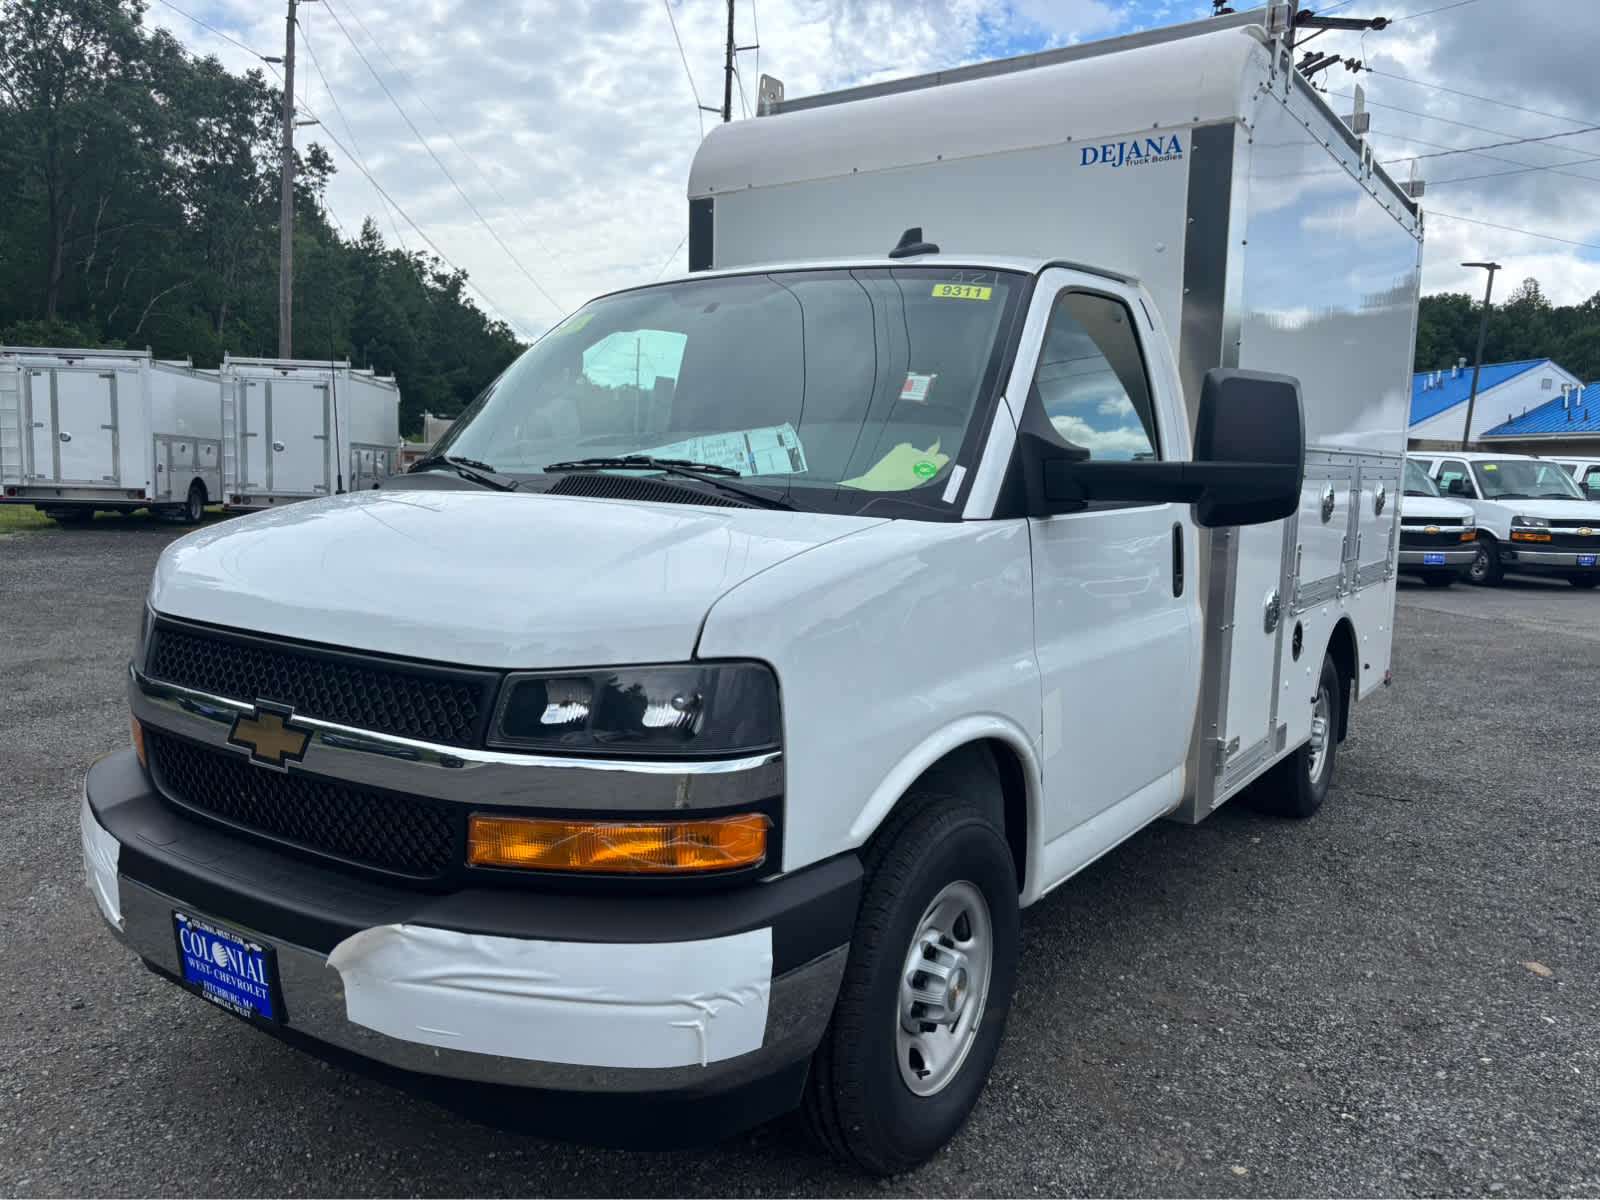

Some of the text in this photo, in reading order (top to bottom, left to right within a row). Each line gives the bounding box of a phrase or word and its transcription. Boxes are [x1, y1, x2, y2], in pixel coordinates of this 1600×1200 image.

[1080, 135, 1182, 168] DEJANA
[1125, 153, 1183, 167] Truck Bodies
[942, 285, 982, 297] 9311
[180, 928, 269, 986] COLONIAL
[213, 968, 267, 1000] CHEVROLET
